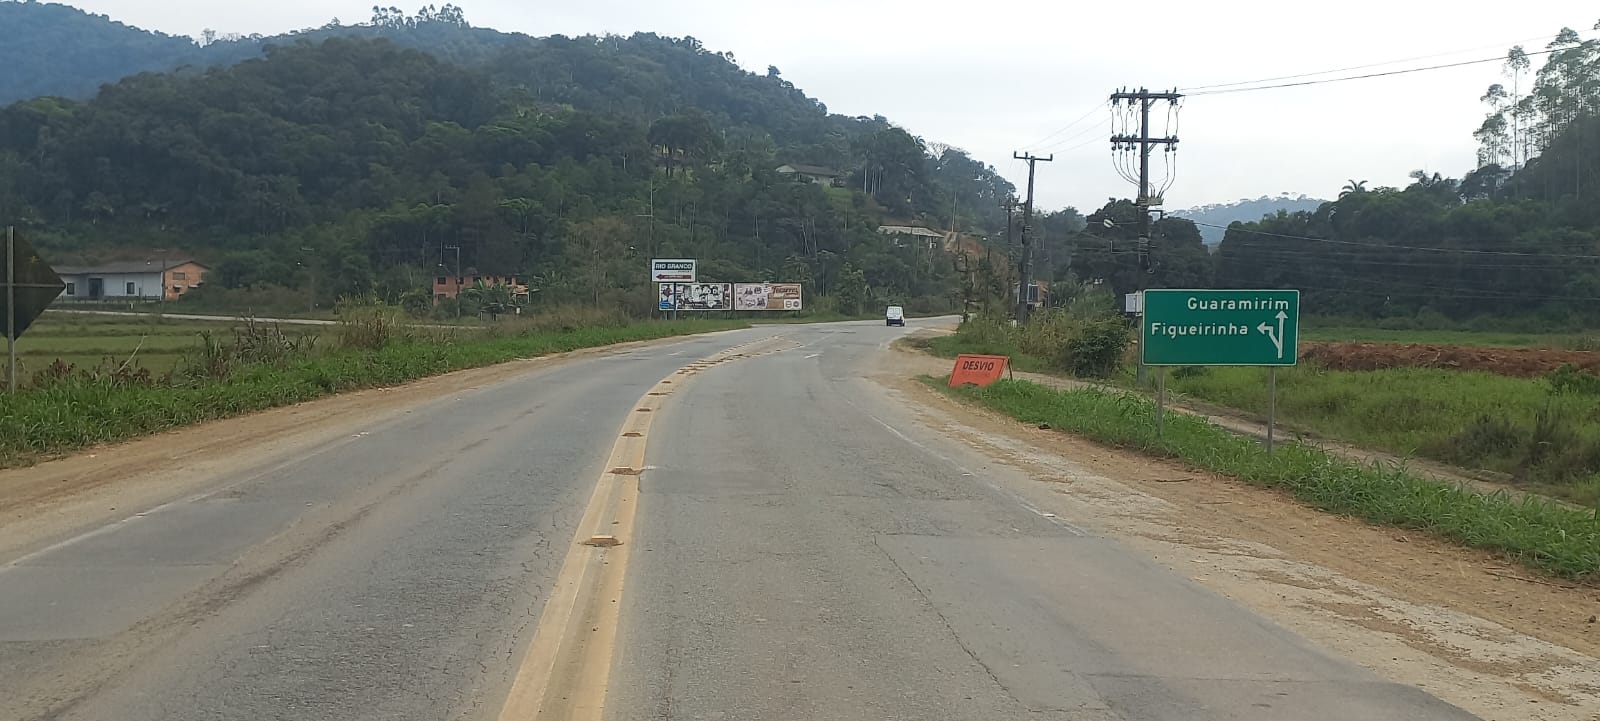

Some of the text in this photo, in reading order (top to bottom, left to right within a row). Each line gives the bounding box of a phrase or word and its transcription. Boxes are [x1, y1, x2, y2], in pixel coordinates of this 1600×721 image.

[1187, 297, 1289, 310] Guaramirim
[1151, 322, 1249, 339] Figueirinha
[962, 360, 995, 371] DESVIO
